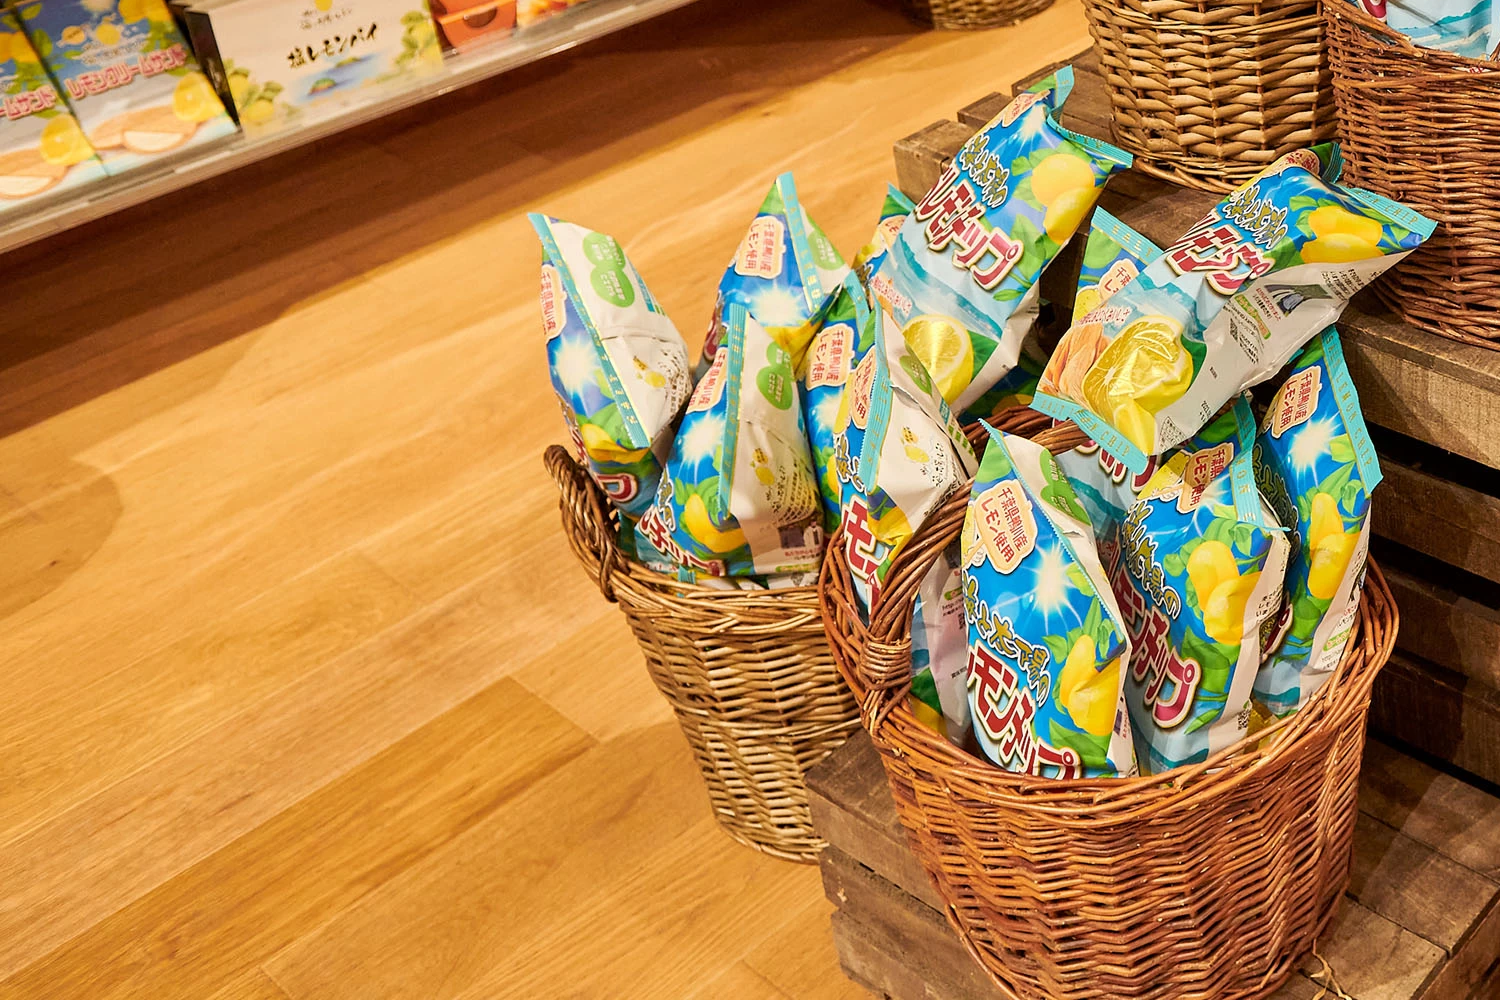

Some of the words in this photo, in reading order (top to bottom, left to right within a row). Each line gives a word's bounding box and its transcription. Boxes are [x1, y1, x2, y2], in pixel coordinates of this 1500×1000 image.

[64, 44, 188, 100] レモンクリームサンド
[287, 22, 379, 70] 塩レモンパイ
[1280, 378, 1298, 430] レモン使用
[981, 497, 1015, 563] レモン使用
[997, 487, 1029, 553] 千葉県鴨川産
